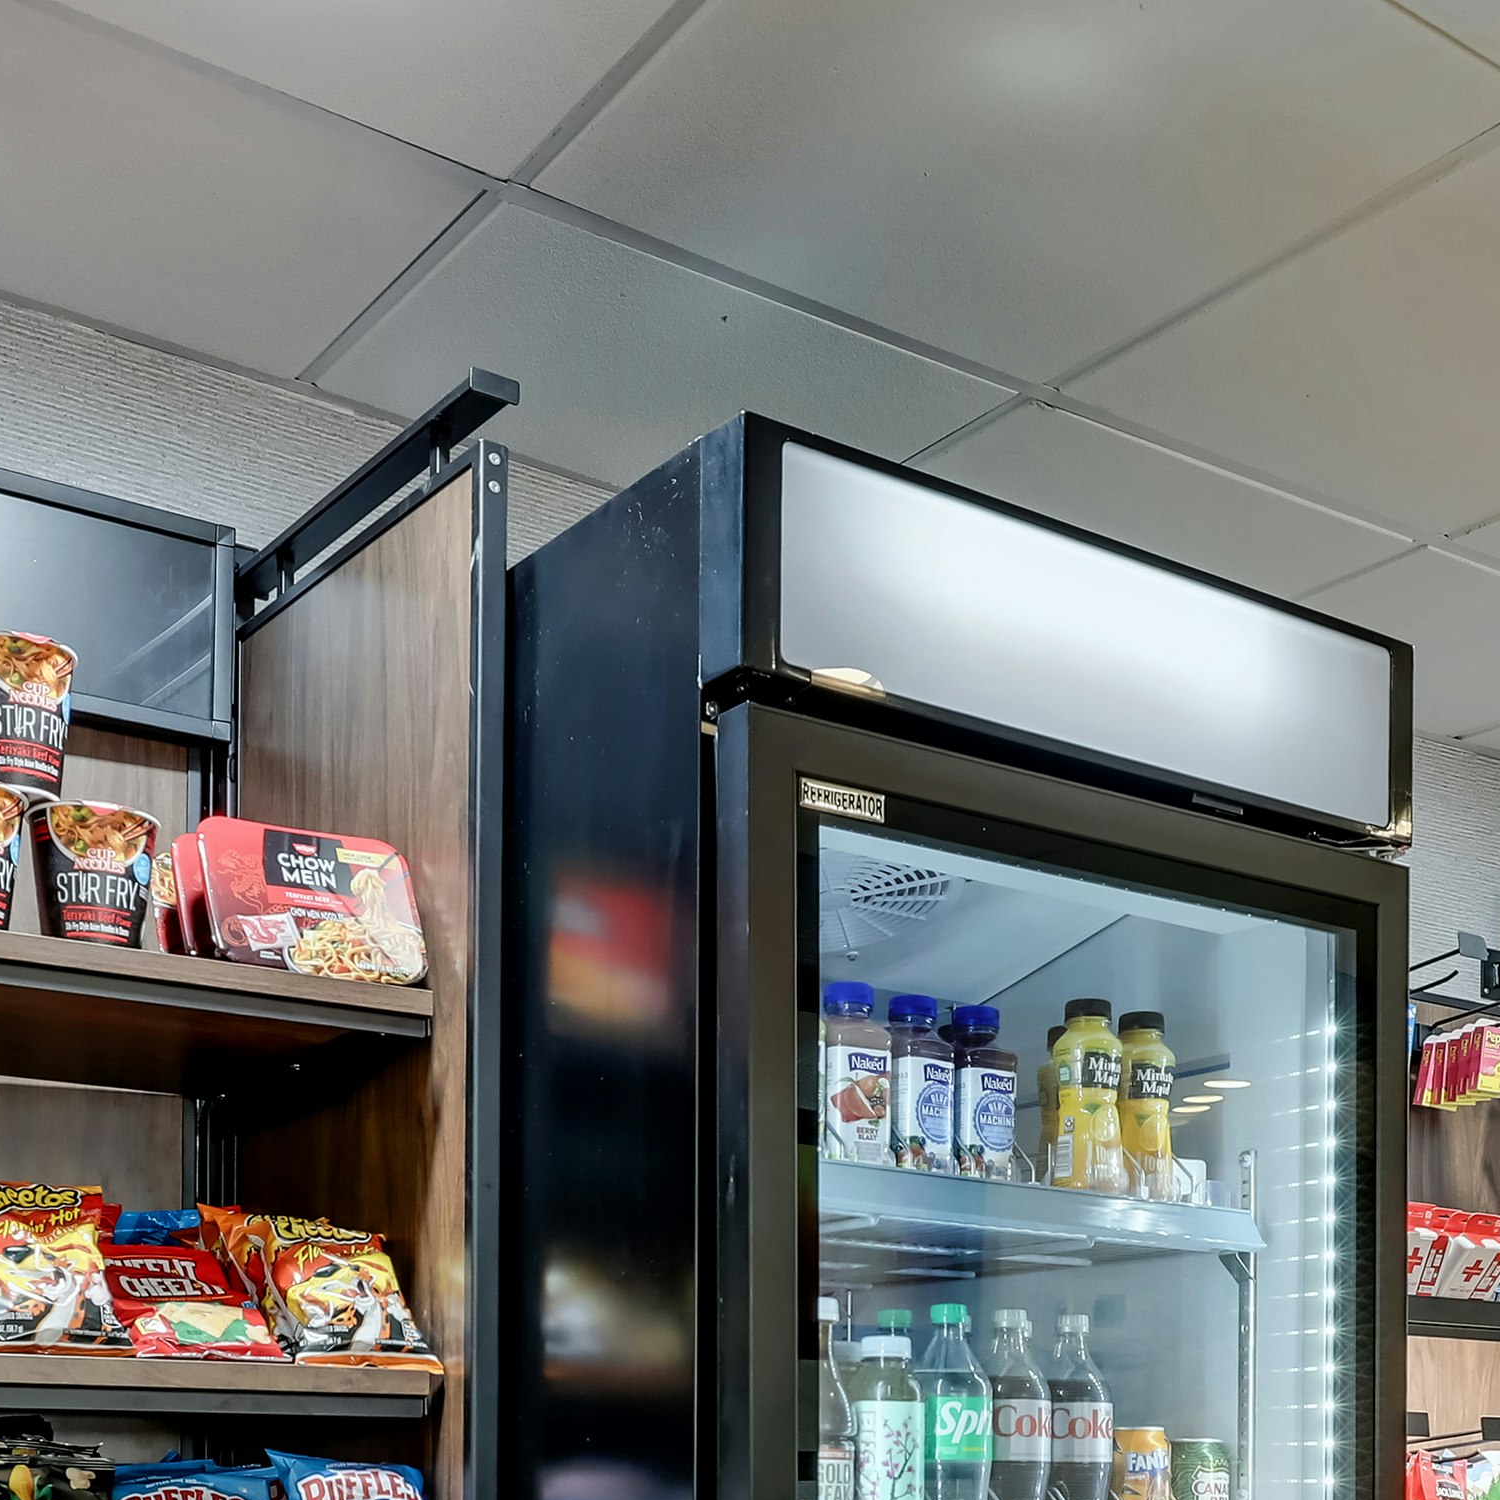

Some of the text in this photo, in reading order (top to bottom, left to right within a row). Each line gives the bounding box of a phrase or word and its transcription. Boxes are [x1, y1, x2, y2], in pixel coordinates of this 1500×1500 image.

[22, 681, 51, 695] CUP
[8, 690, 58, 712] NOODLES
[39, 710, 65, 751] FRY
[802, 782, 883, 819] REFRIGERATOR
[86, 847, 116, 860] CUP
[277, 852, 336, 873] CHOW
[73, 857, 126, 874] NOODLES
[280, 866, 337, 889] MEIN
[105, 875, 139, 911] FRY
[284, 891, 314, 902] TERIYAKI
[63, 910, 95, 921] Teriyaki
[930, 1093, 948, 1104] BLUE
[988, 1103, 1008, 1114] BLUE
[979, 1113, 1015, 1127] MACHINE
[856, 1126, 879, 1135] BERRY
[857, 1133, 878, 1141] BLAST
[49, 1207, 83, 1226] Hot
[936, 1400, 993, 1444] Spri
[992, 1404, 1052, 1438] Cok
[1051, 1407, 1113, 1440] Coke
